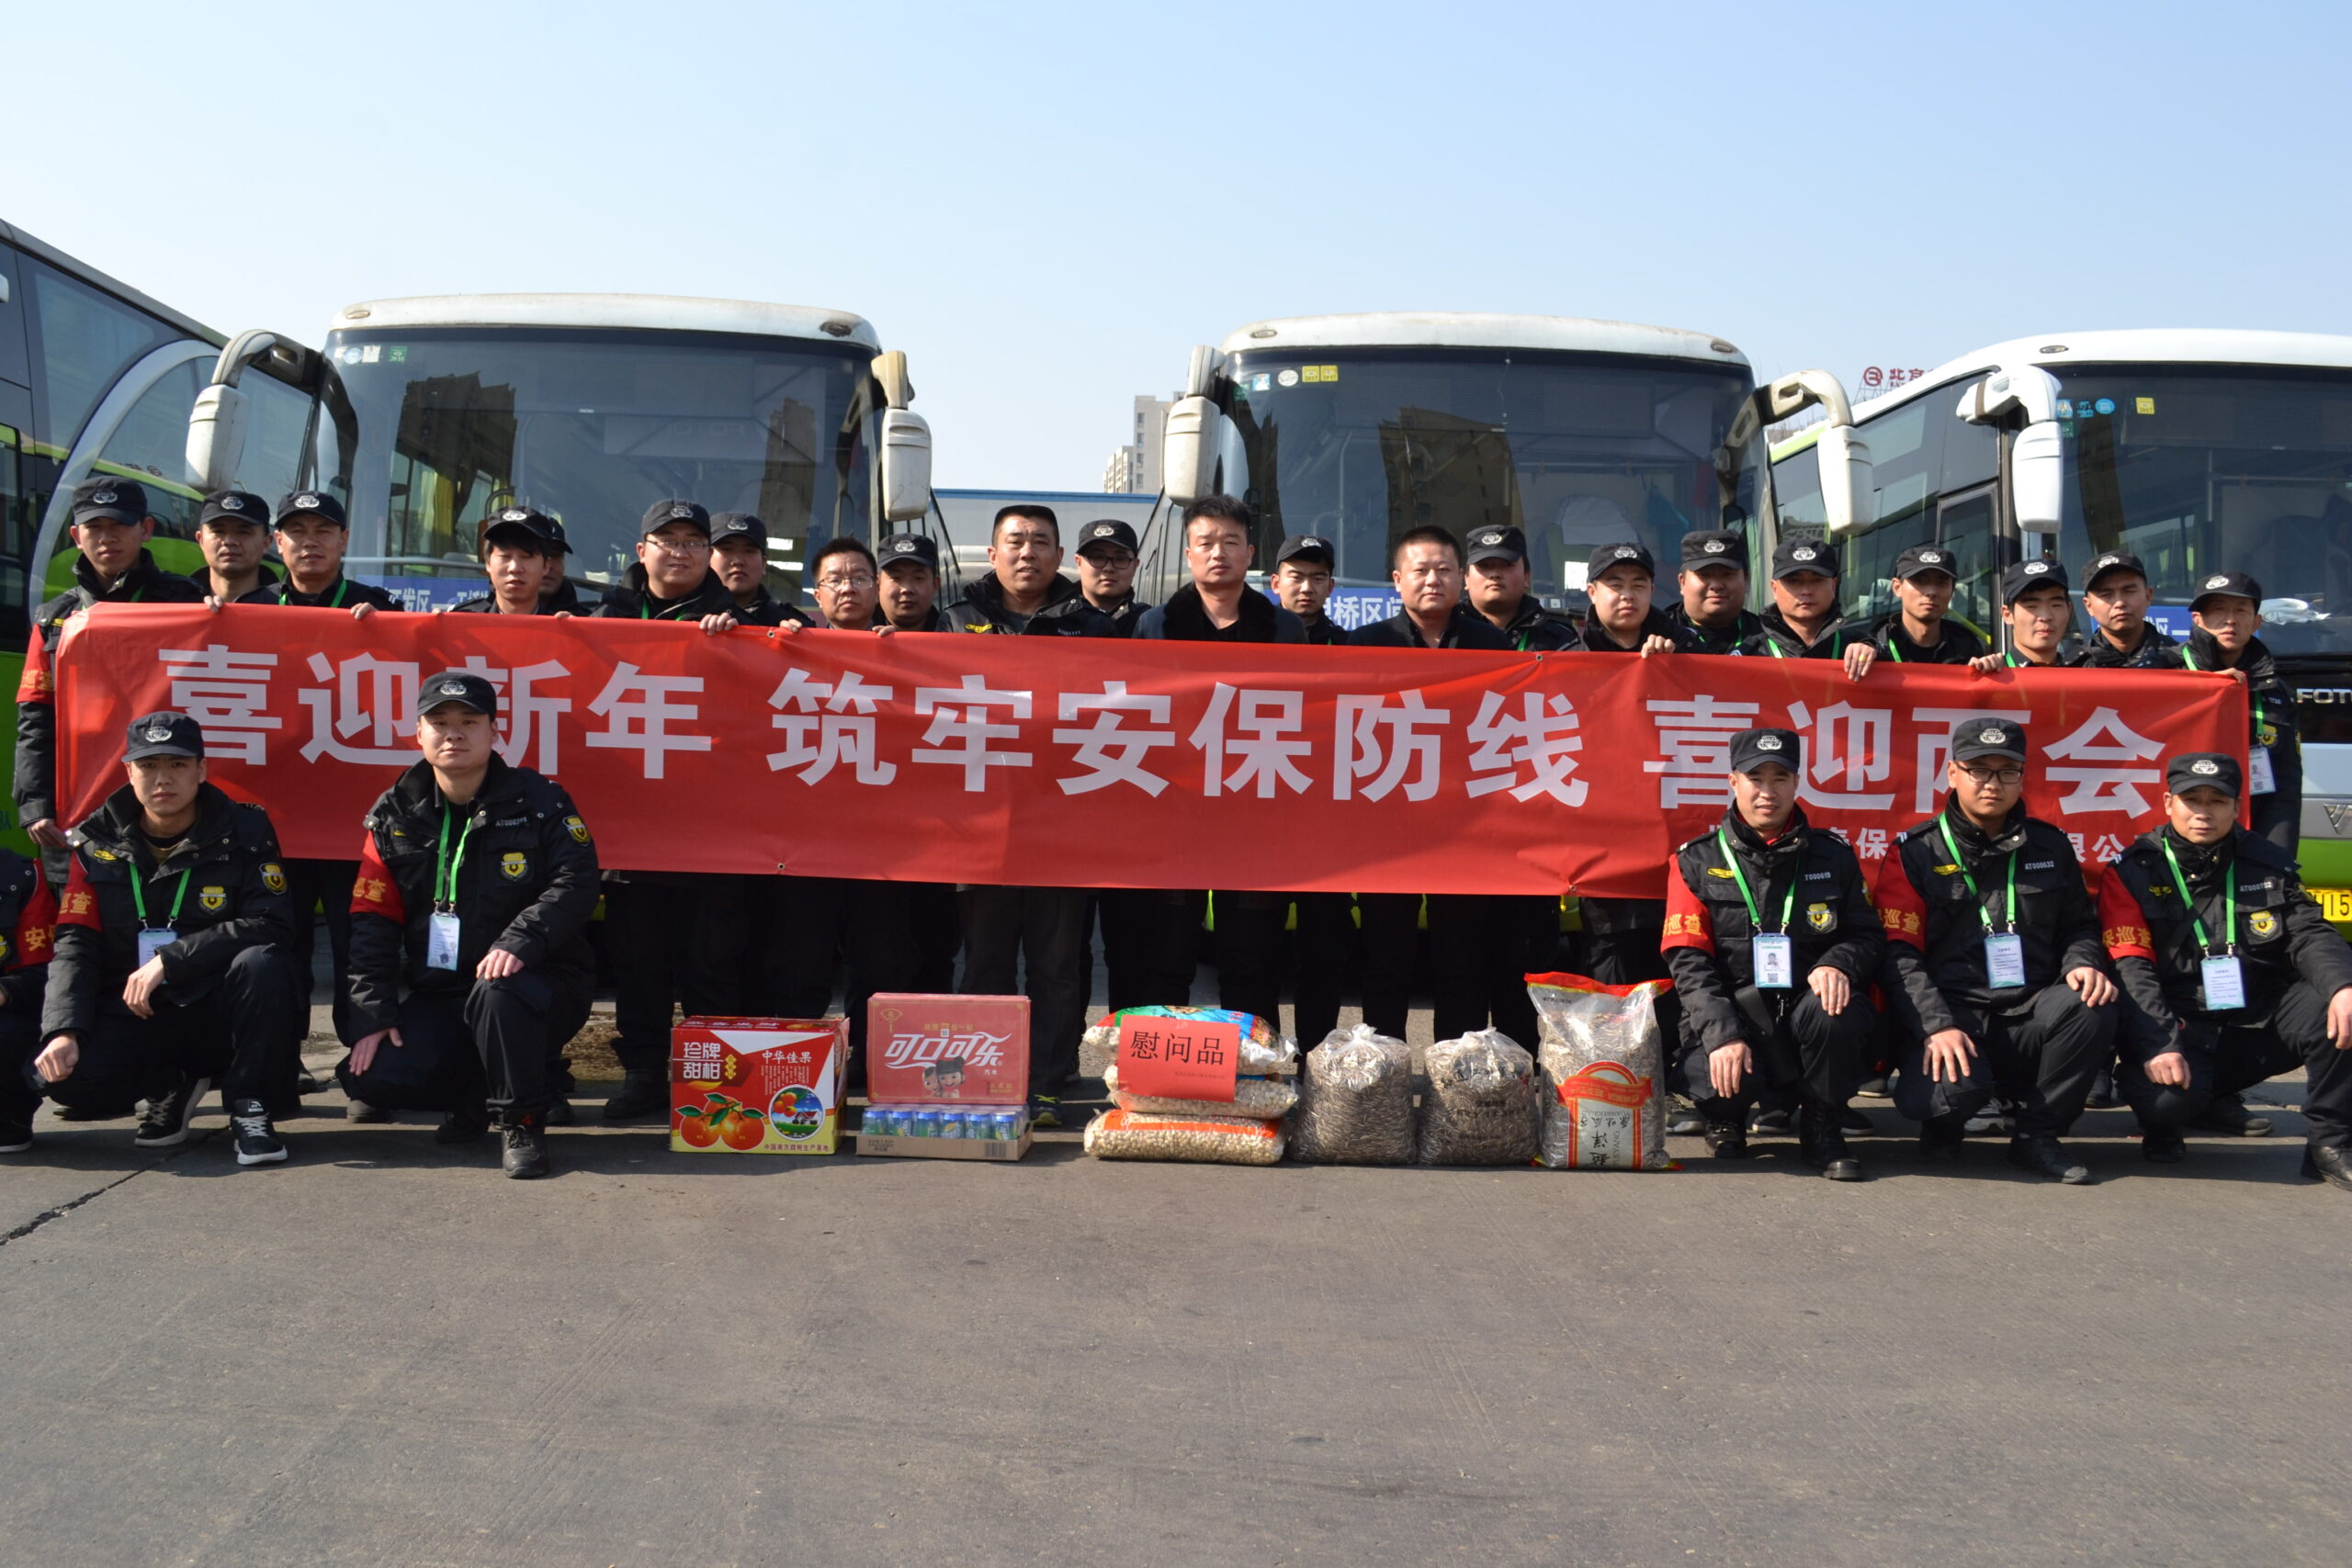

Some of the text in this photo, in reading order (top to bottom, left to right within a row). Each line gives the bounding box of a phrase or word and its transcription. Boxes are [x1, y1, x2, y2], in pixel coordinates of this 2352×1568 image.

[1889, 367, 1933, 381] 北京
[2297, 688, 2352, 704] FOT
[159, 645, 711, 779] 喜迎新年
[766, 668, 1589, 807] 筑牢安保防线
[1663, 913, 1702, 936] 巡查
[1878, 908, 1920, 935] 巡查
[762, 1050, 812, 1064] 中华佳果
[885, 1031, 1012, 1069] 可口可乐
[1129, 1030, 1225, 1066] 慰问品
[683, 1062, 720, 1079] 甜柑
